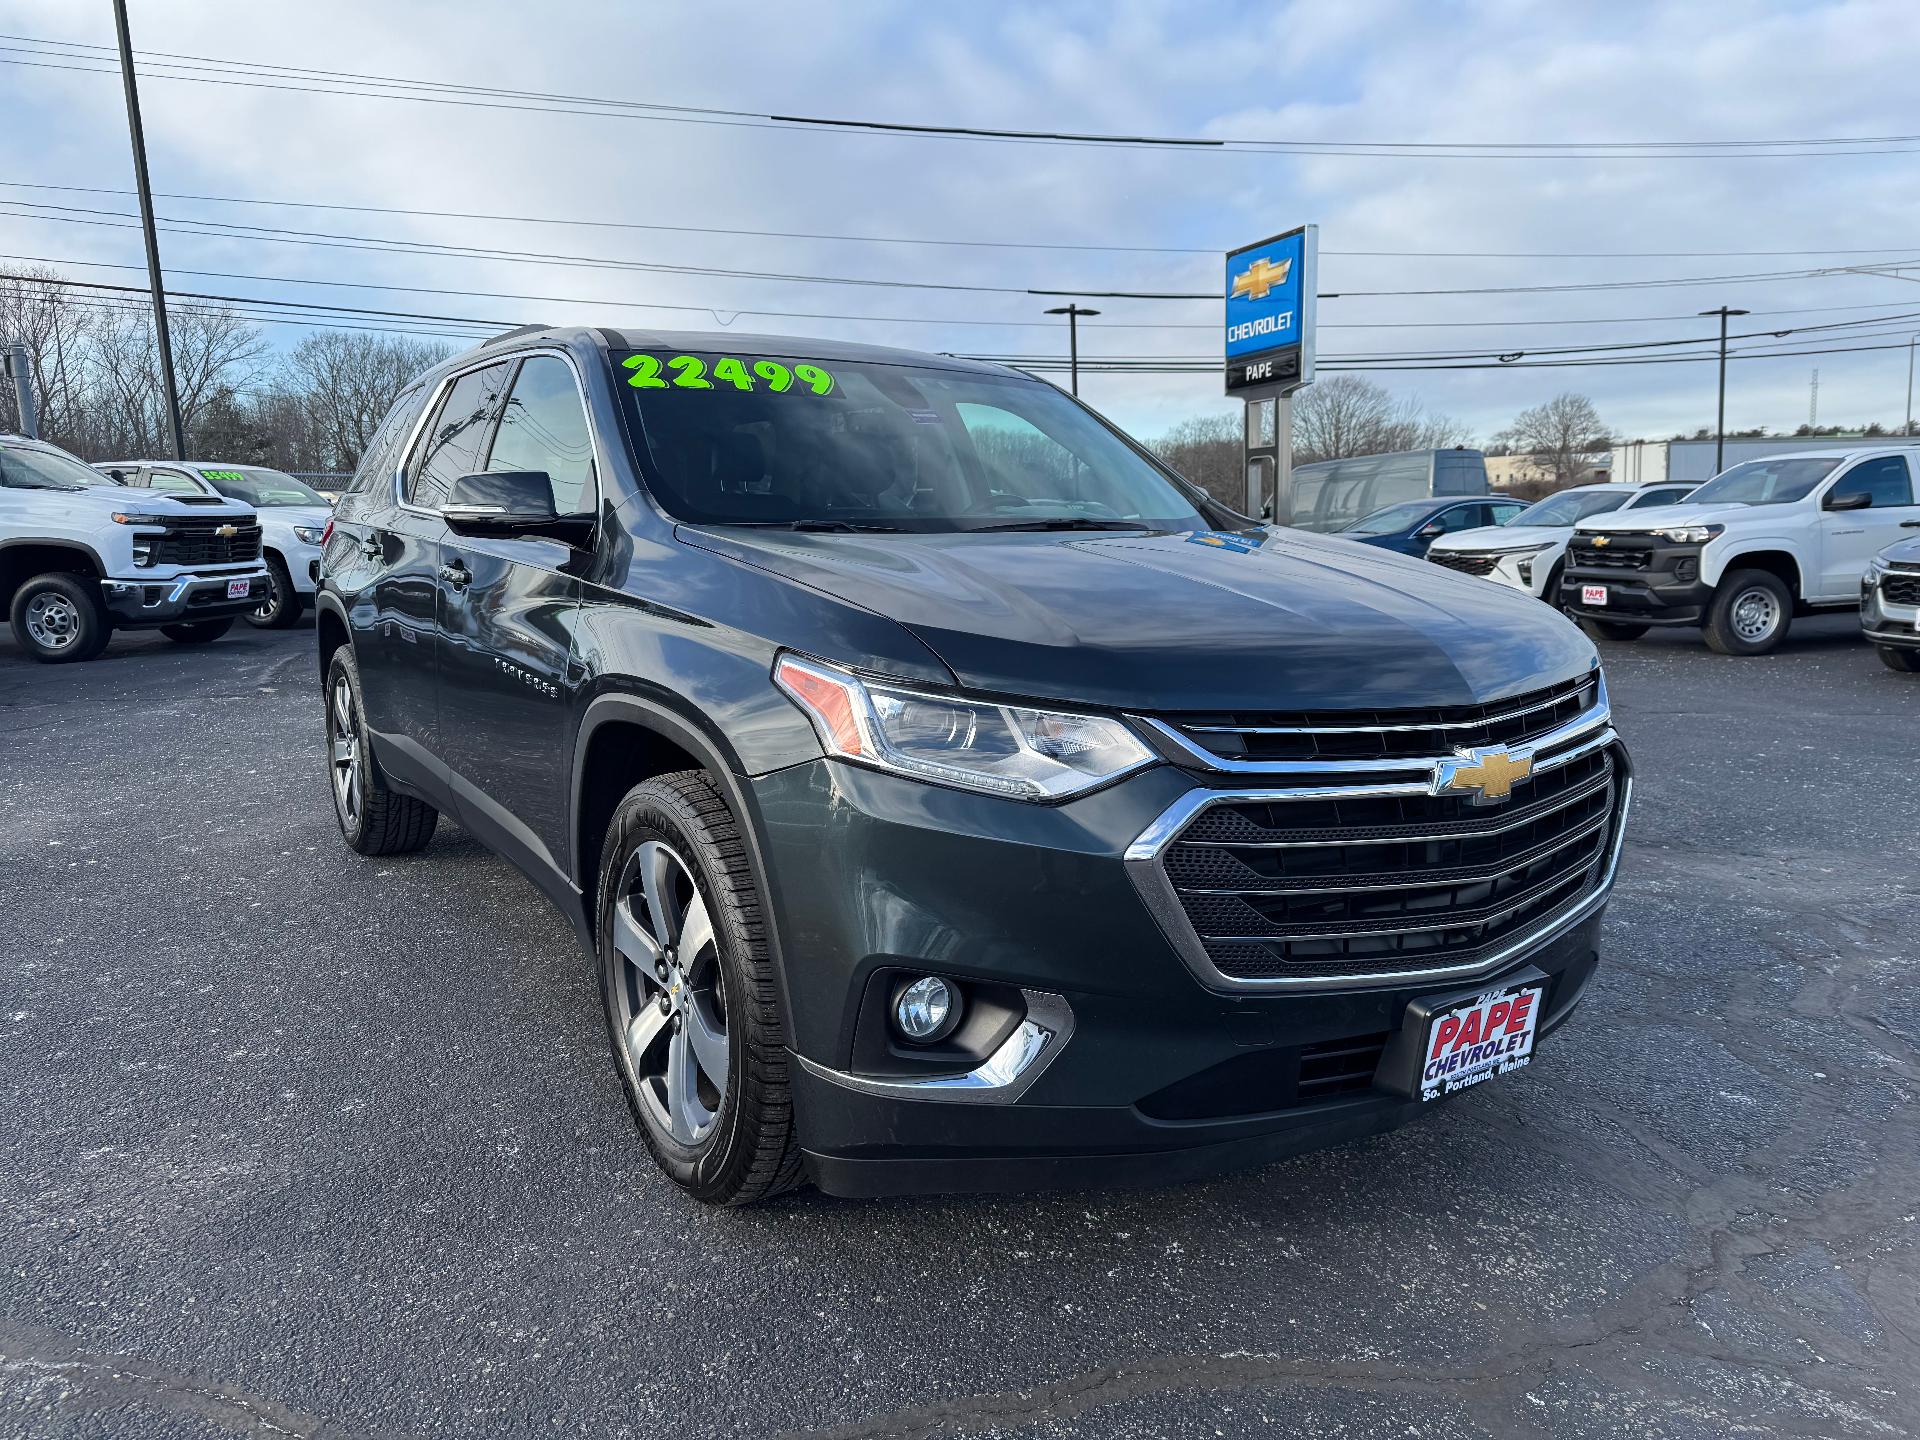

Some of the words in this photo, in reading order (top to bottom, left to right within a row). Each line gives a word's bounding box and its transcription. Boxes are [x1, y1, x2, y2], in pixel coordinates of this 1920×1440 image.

[1228, 310, 1293, 343] CHEVROLET
[621, 354, 835, 396] 22499
[1246, 361, 1273, 382] PAPE
[230, 582, 249, 591] PAPE
[1585, 589, 1604, 598] PAPE
[1475, 987, 1509, 1006] PAPE
[1431, 992, 1535, 1061] PAPE
[1424, 1030, 1532, 1081] CHEVROLET
[1422, 1087, 1441, 1102] So.
[1444, 1069, 1495, 1094] Portland,
[1498, 1055, 1531, 1075] Maine
